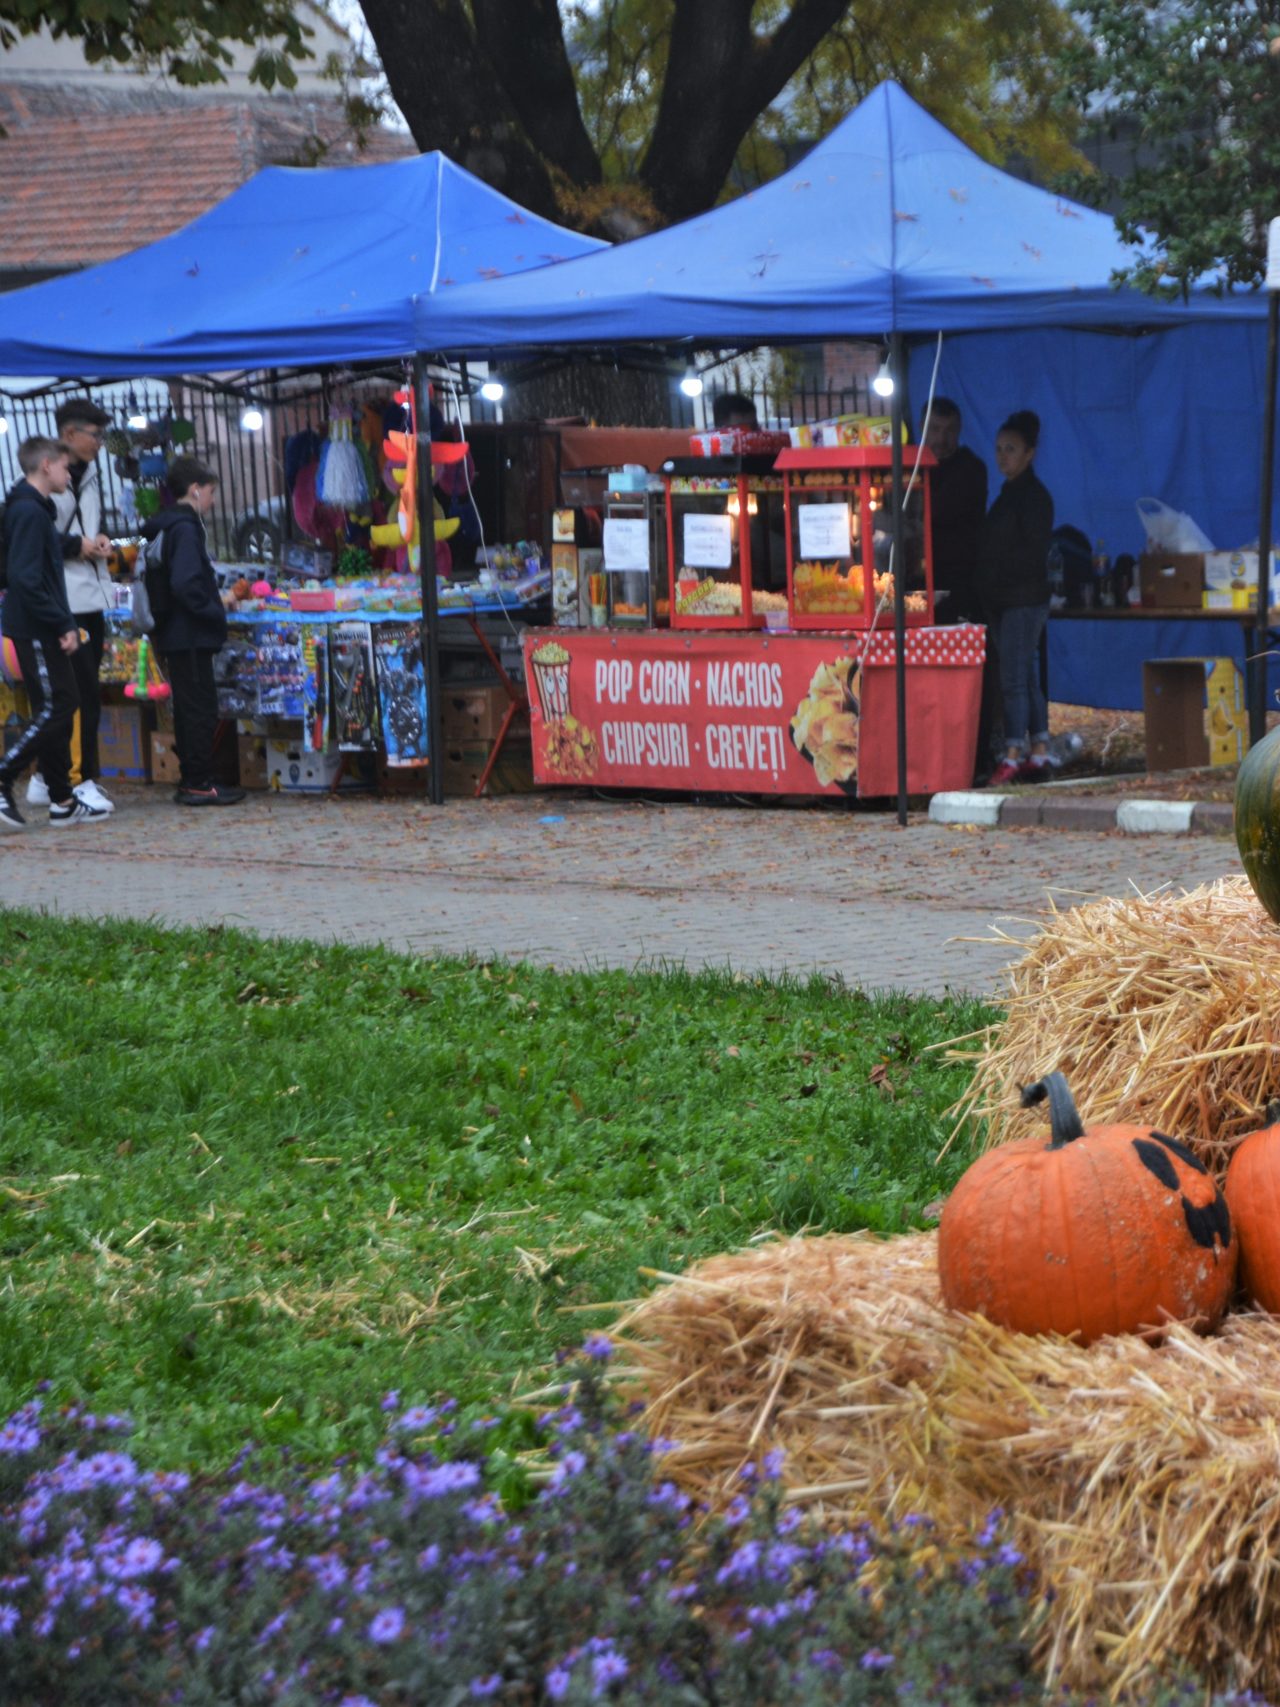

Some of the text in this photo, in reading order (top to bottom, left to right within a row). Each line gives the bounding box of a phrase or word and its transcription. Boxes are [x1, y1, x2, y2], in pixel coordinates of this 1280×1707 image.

[596, 659, 783, 708] POP CORN NACHOS
[602, 721, 690, 768] CHIPSURI
